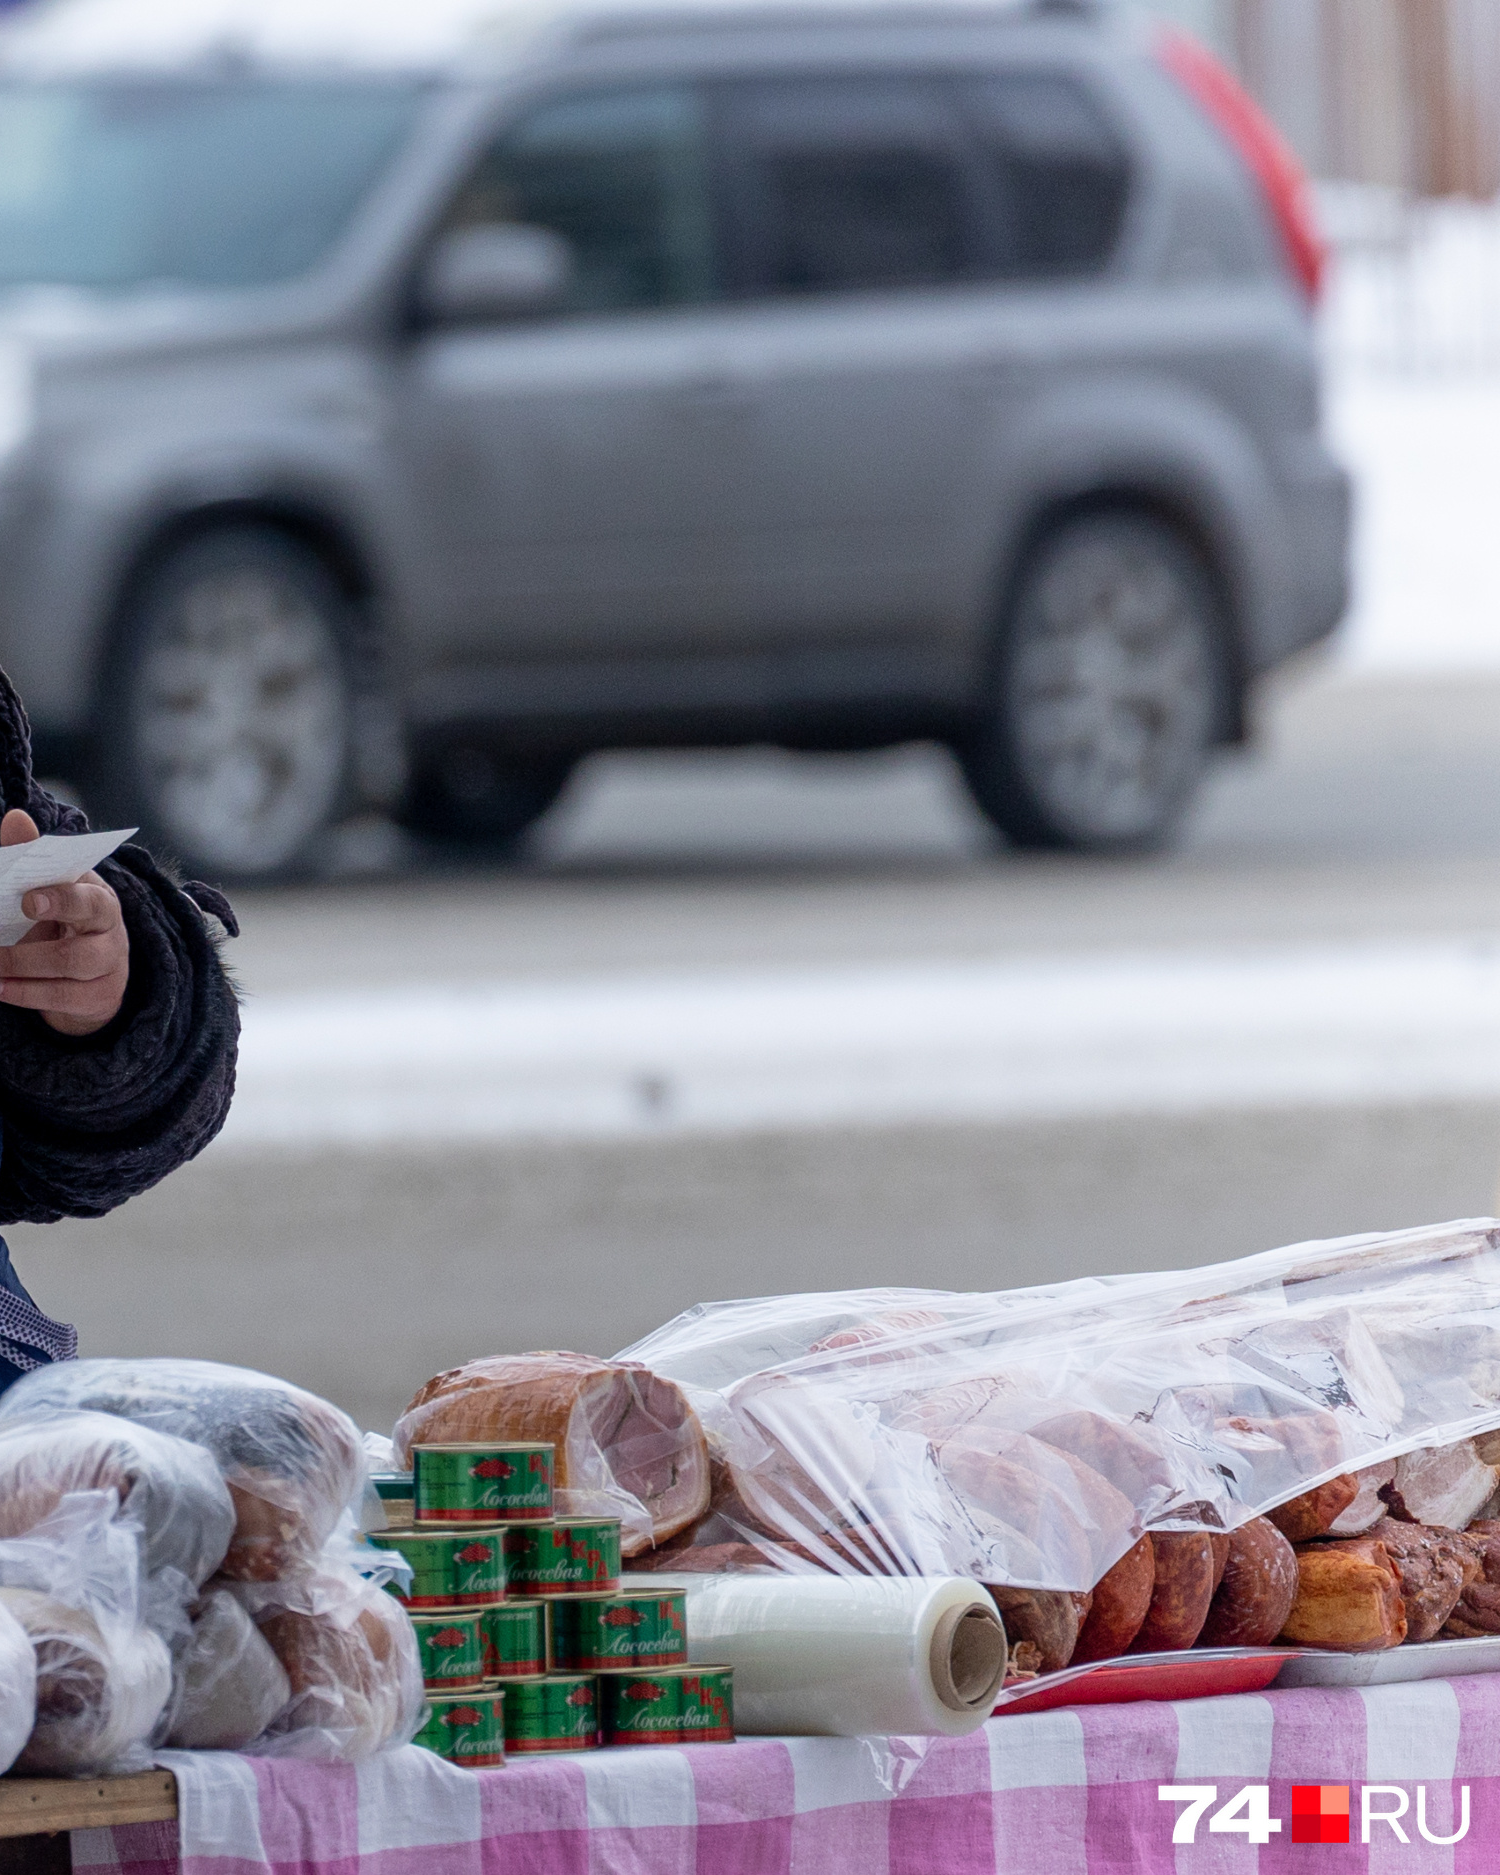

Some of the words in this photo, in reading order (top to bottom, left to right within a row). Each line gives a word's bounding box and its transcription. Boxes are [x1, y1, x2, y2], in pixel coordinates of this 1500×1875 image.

[462, 1484, 549, 1507] Лососевая
[552, 1529, 609, 1580] ИКРА
[593, 1631, 681, 1655] Лососевая
[683, 1676, 729, 1725] ИКРА
[617, 1706, 710, 1729] Лососевая
